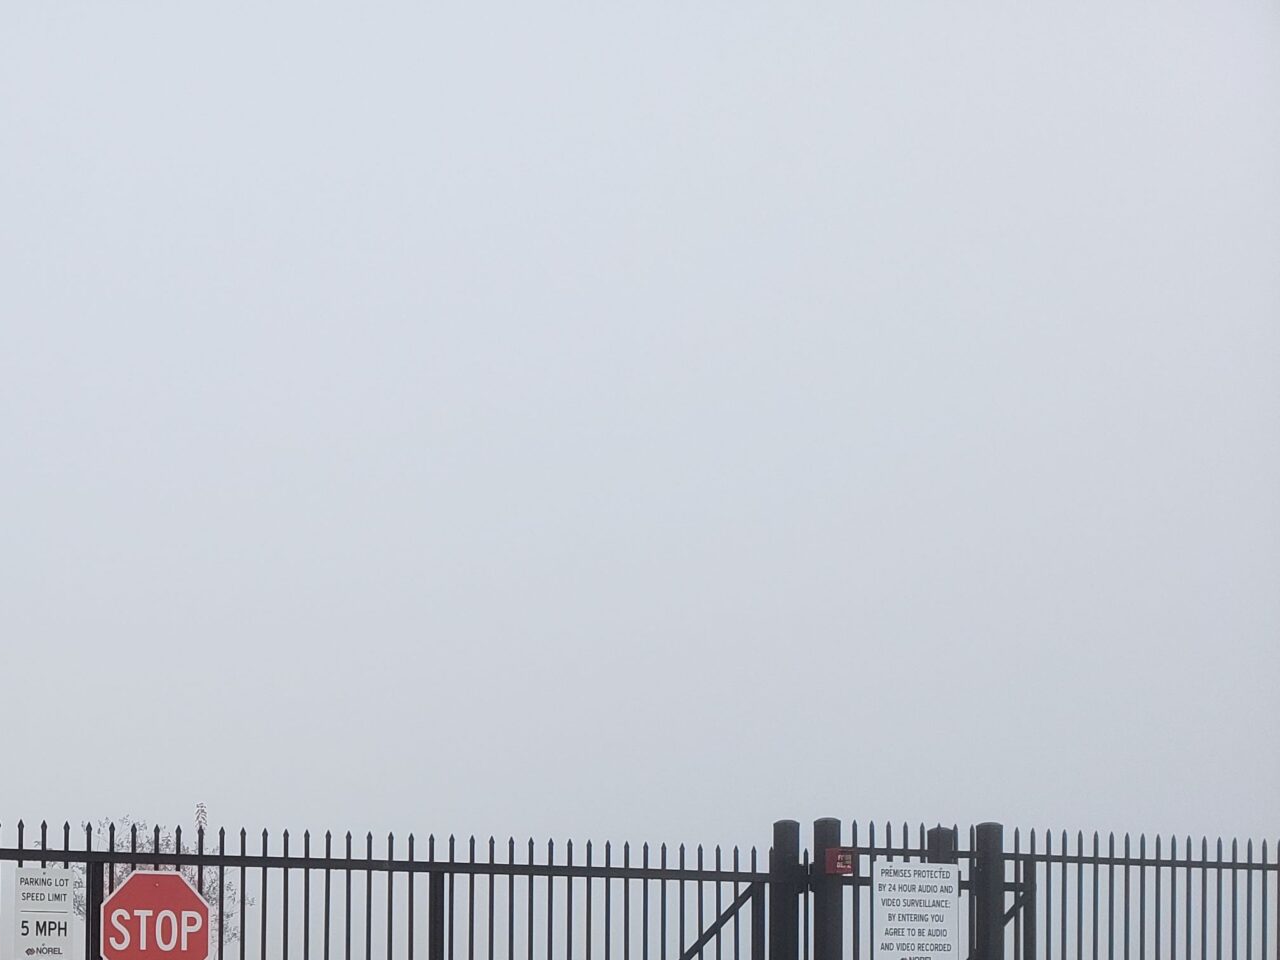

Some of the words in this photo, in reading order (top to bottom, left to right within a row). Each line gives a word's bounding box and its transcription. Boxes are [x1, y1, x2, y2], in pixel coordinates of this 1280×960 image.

[881, 869, 911, 877] PREMISES
[913, 869, 950, 879] PROTECTED
[20, 877, 52, 886] PARKING
[55, 879, 69, 887] LOT
[878, 884, 886, 892] BY
[888, 884, 896, 892] 24
[898, 884, 916, 892] HOUR
[918, 885, 937, 893] AUDIO
[940, 885, 953, 893] AND
[22, 893, 45, 901] SPEED
[48, 893, 67, 902] LIMIT
[881, 898, 901, 907] VIDEO
[888, 913, 896, 921] BY
[898, 914, 929, 922] ENTERING
[931, 914, 944, 922] YOU
[21, 921, 29, 936] 5
[36, 921, 67, 937] MPH
[109, 908, 202, 951] STOP
[885, 928, 905, 936] AGREE
[927, 929, 947, 937] AUDIO
[36, 947, 62, 955] NOREL
[880, 943, 894, 951] AND
[897, 943, 915, 951] VIDEO
[917, 944, 951, 952] RECORDED
